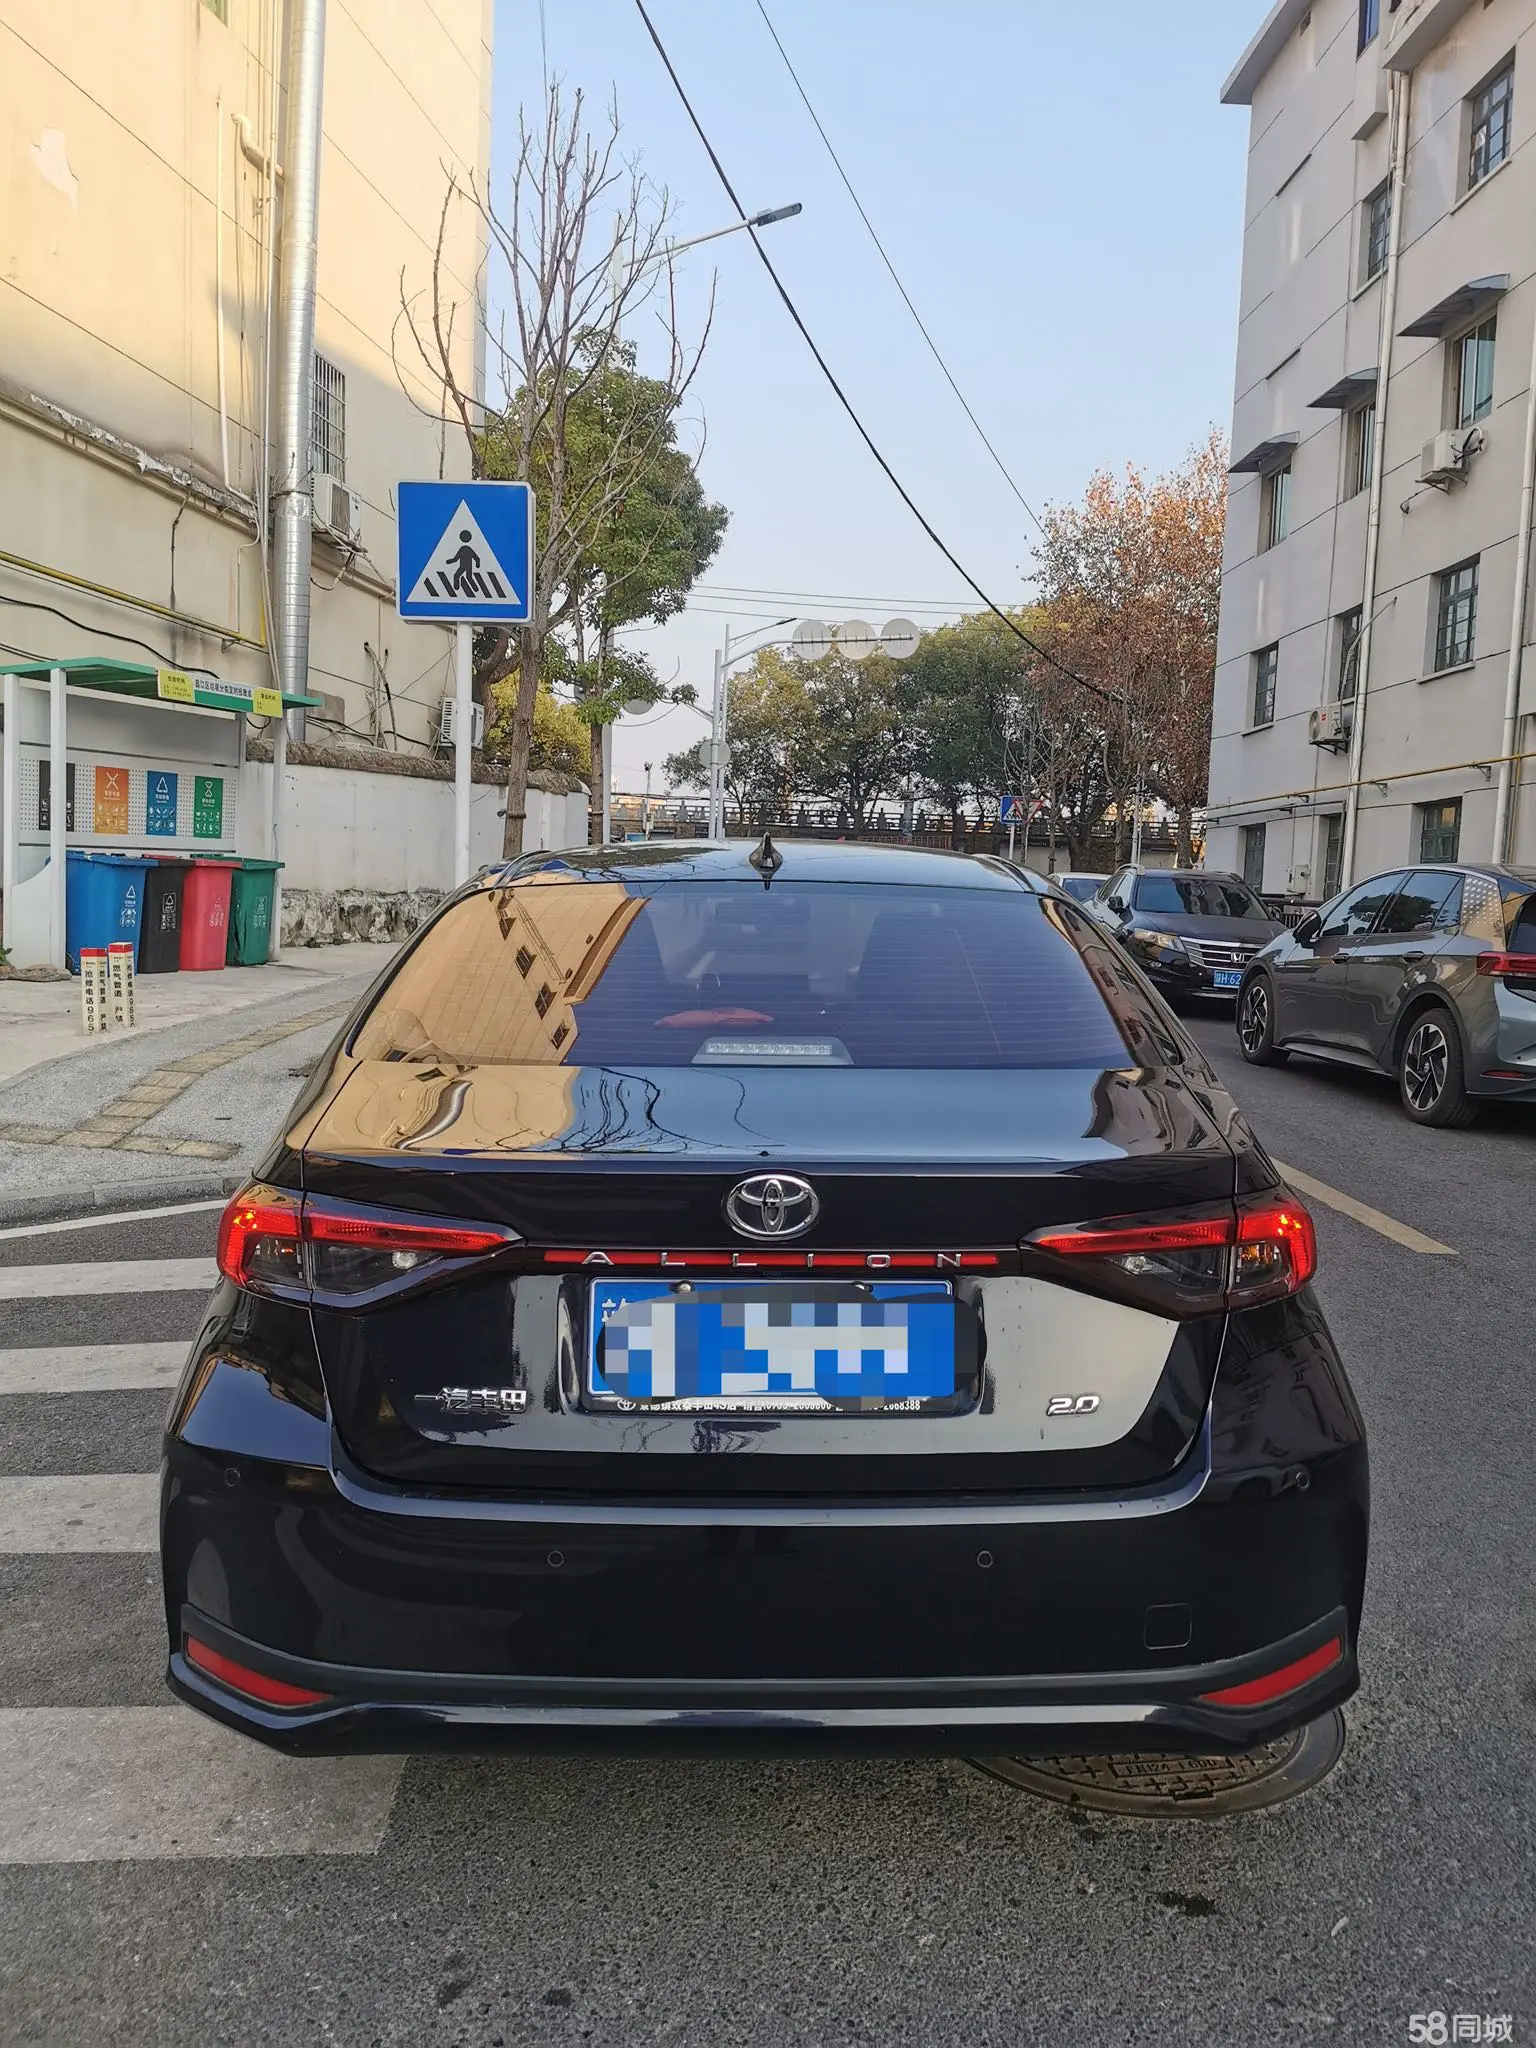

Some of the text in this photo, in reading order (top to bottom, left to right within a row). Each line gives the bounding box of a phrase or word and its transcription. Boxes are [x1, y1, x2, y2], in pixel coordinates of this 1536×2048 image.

[581, 1251, 962, 1268] ALLION
[414, 1386, 528, 1414] 一汽丰田
[1046, 1395, 1100, 1416] 2.0
